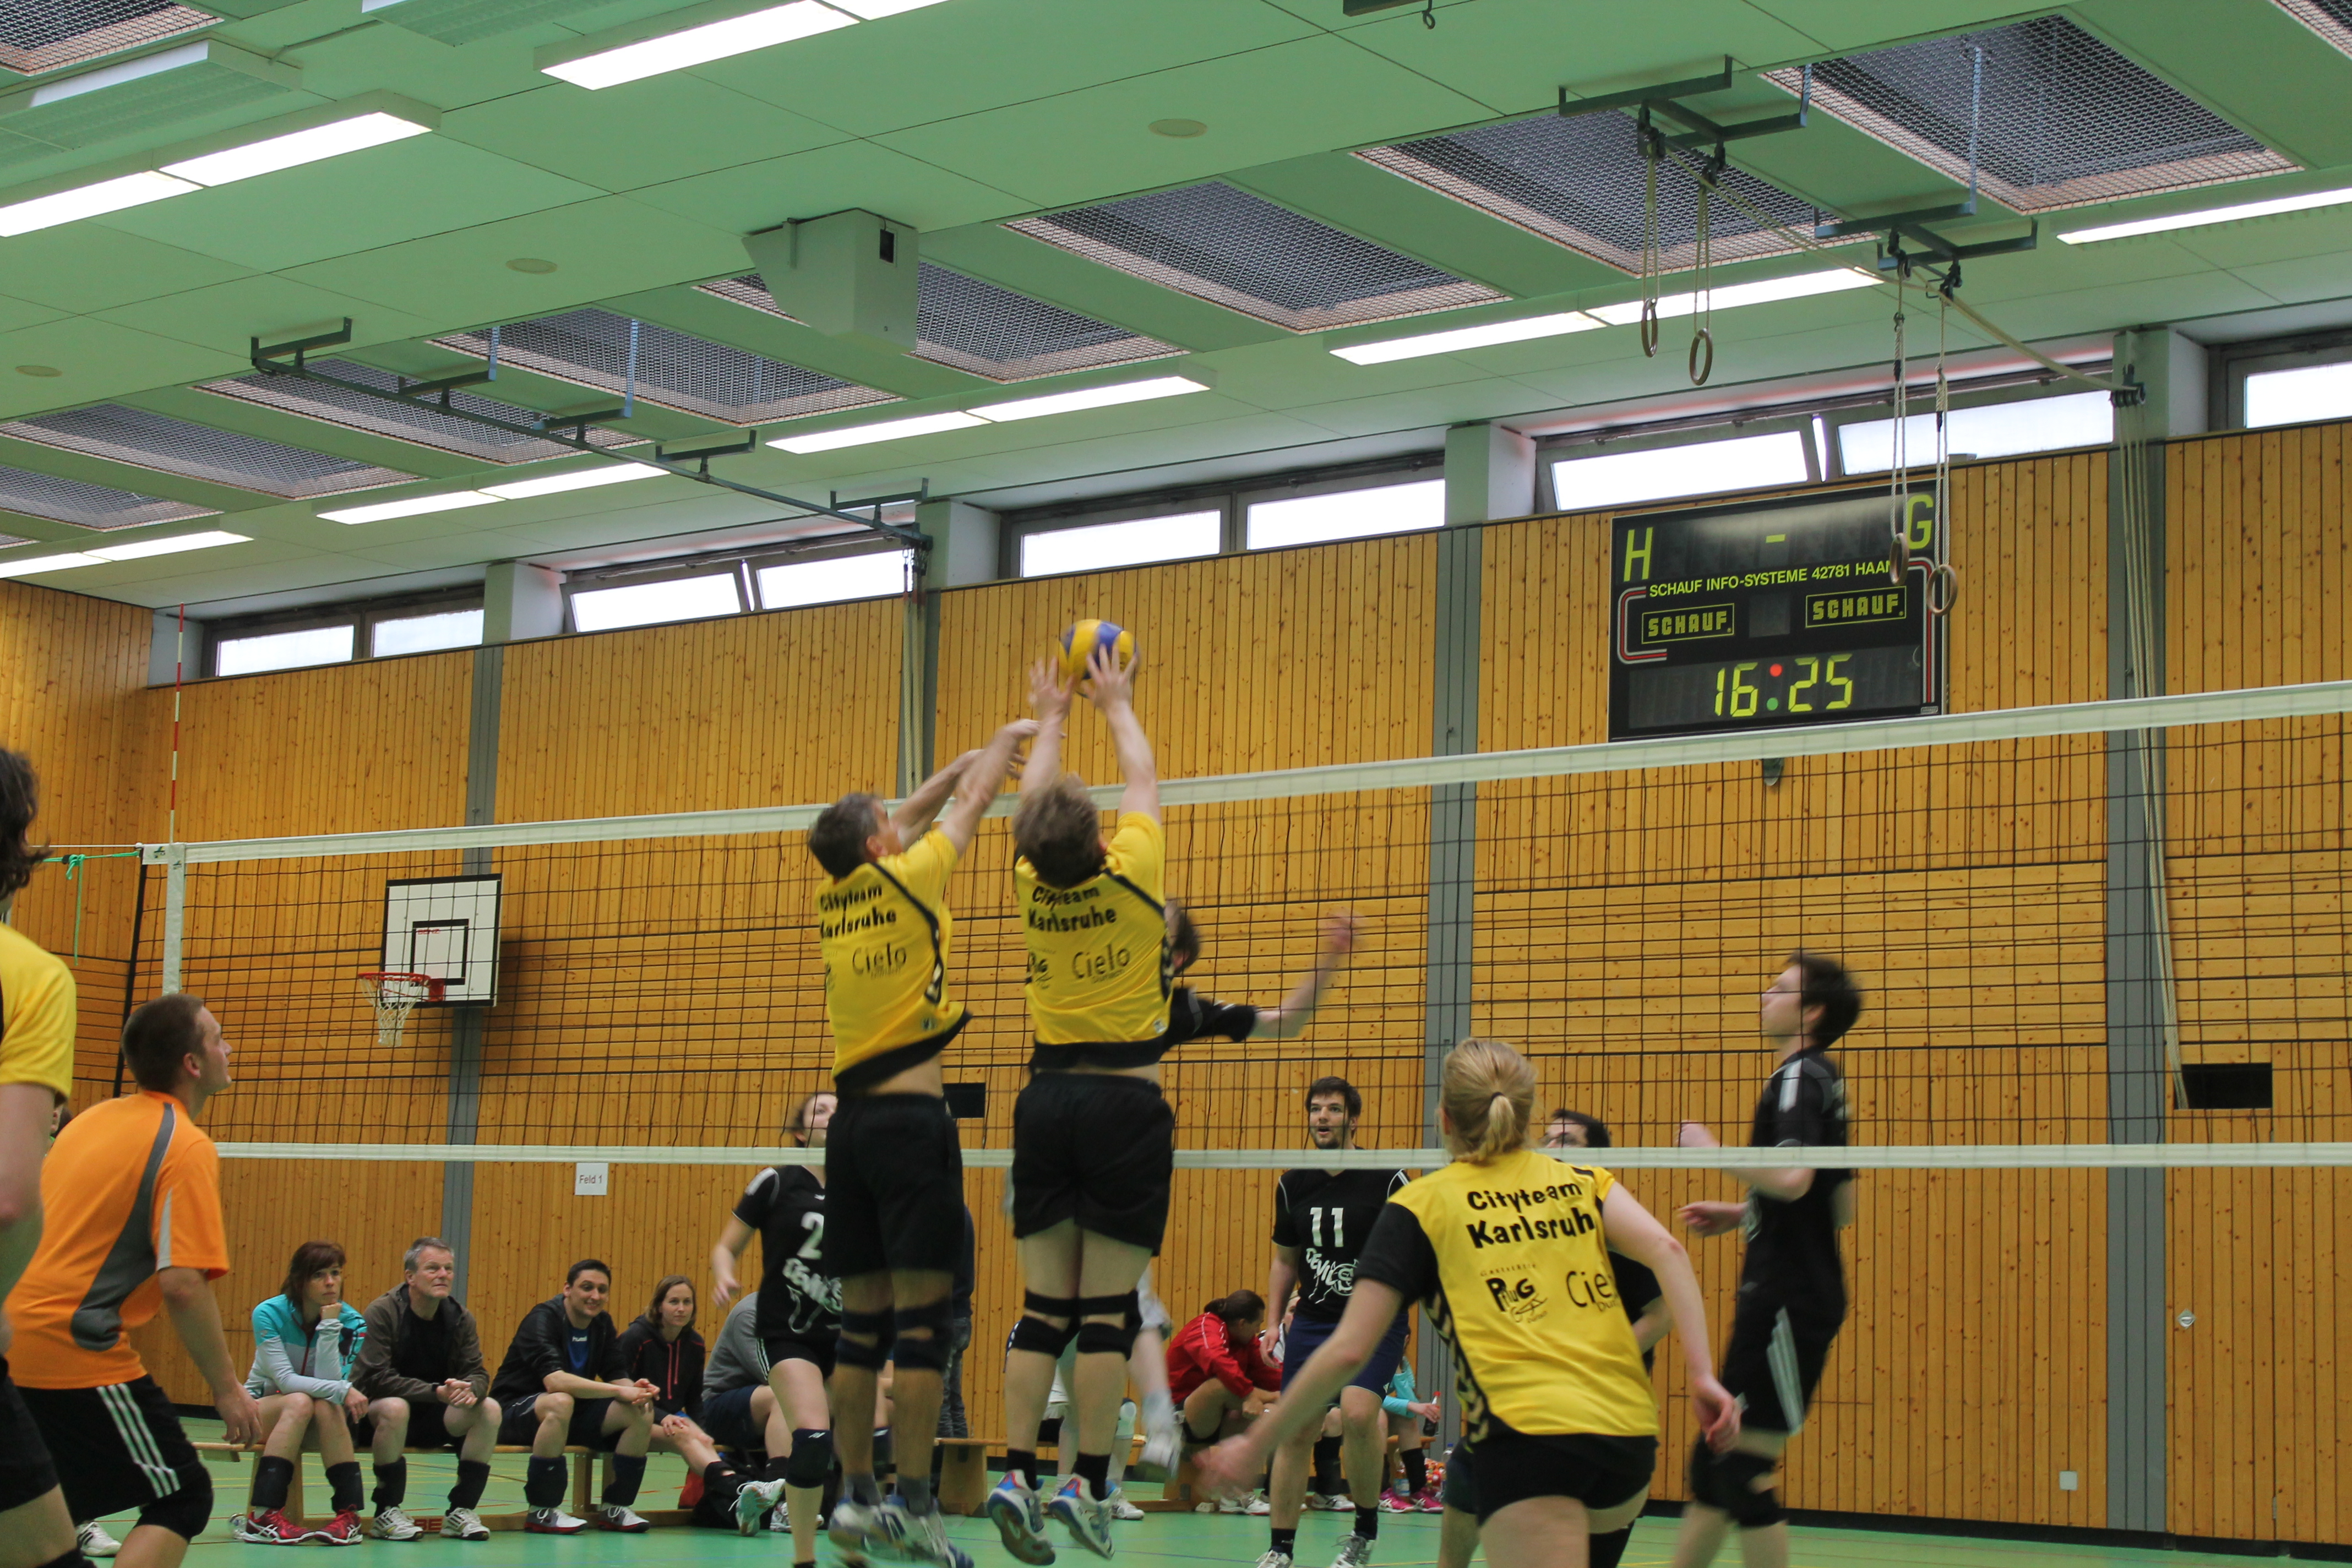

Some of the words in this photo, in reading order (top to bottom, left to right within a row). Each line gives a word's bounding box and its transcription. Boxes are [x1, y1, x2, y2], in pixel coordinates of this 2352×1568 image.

[1624, 527, 1653, 582] H
[1907, 494, 1934, 549] G
[1649, 579, 1702, 597] SCHAUF
[1706, 568, 1808, 591] INFO-SYSTEME
[1811, 563, 1850, 580] 42781
[1812, 593, 1899, 620] SCHAUF
[1648, 611, 1727, 638] SCHAUF
[1028, 905, 1117, 933] Karlsruhe
[852, 943, 907, 976] Cielo
[1072, 944, 1130, 979] Cielo
[579, 1175, 596, 1184] Feld
[598, 1174, 603, 1184] 1
[1467, 1183, 1582, 1213] Cityteam
[1310, 1207, 1344, 1248] 11
[1466, 1207, 1595, 1249] Karlsruh
[1566, 1271, 1613, 1308] Cie
